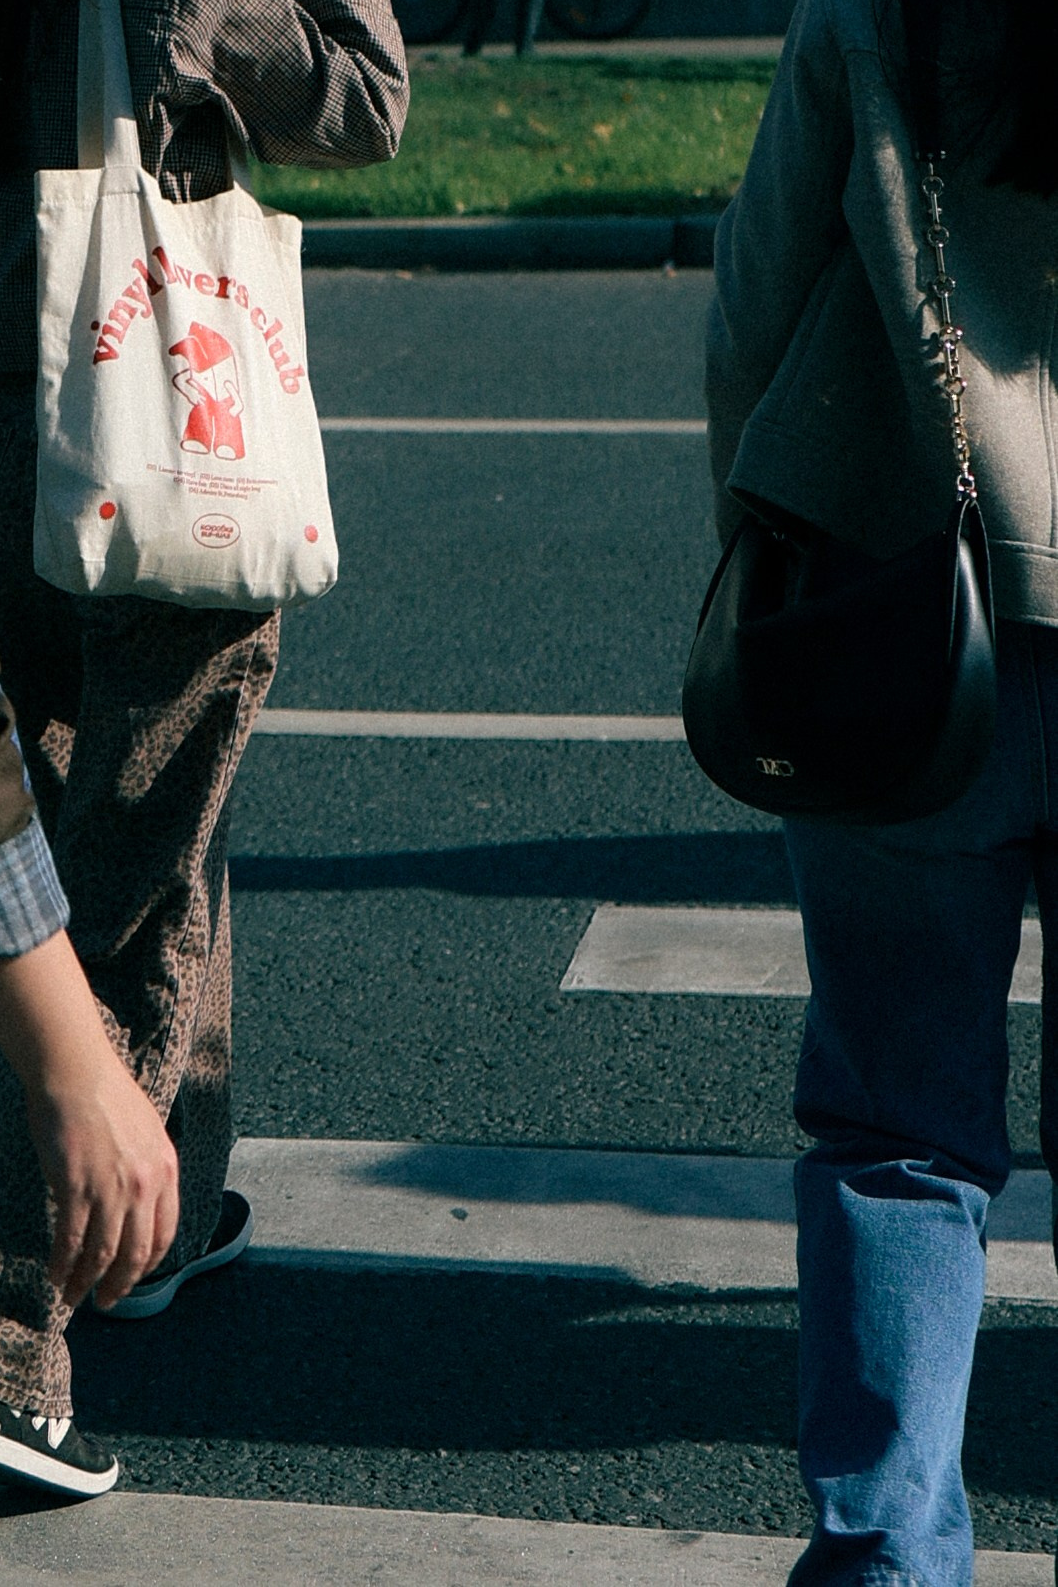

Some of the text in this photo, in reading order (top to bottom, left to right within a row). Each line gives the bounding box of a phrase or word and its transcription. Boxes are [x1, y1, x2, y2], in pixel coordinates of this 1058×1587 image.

[91, 246, 307, 395] vinyl lvers club
